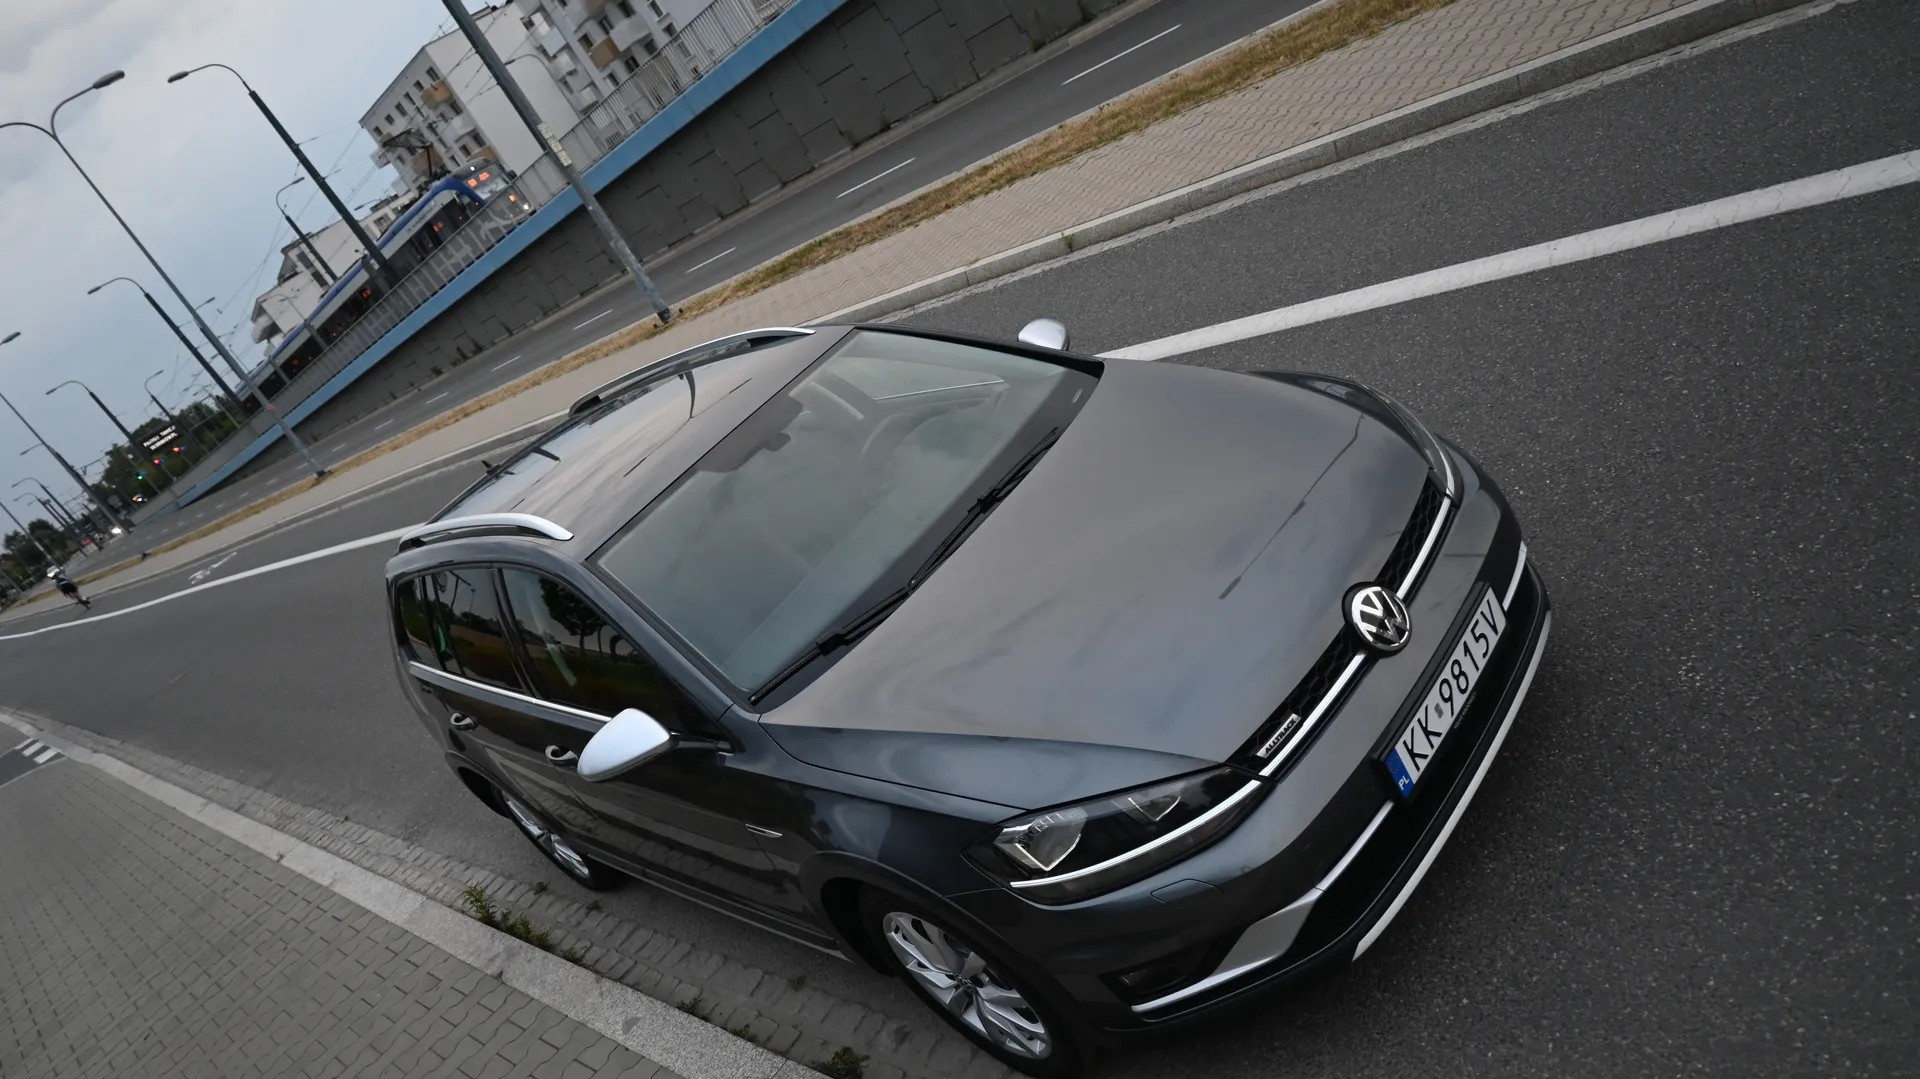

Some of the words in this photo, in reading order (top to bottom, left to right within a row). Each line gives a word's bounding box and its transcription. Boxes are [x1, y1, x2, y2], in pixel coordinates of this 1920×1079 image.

[1402, 703, 1443, 772] KK
[1438, 598, 1499, 718] 9815V
[1264, 717, 1297, 756] ALLTRACK
[1398, 775, 1410, 791] PL
